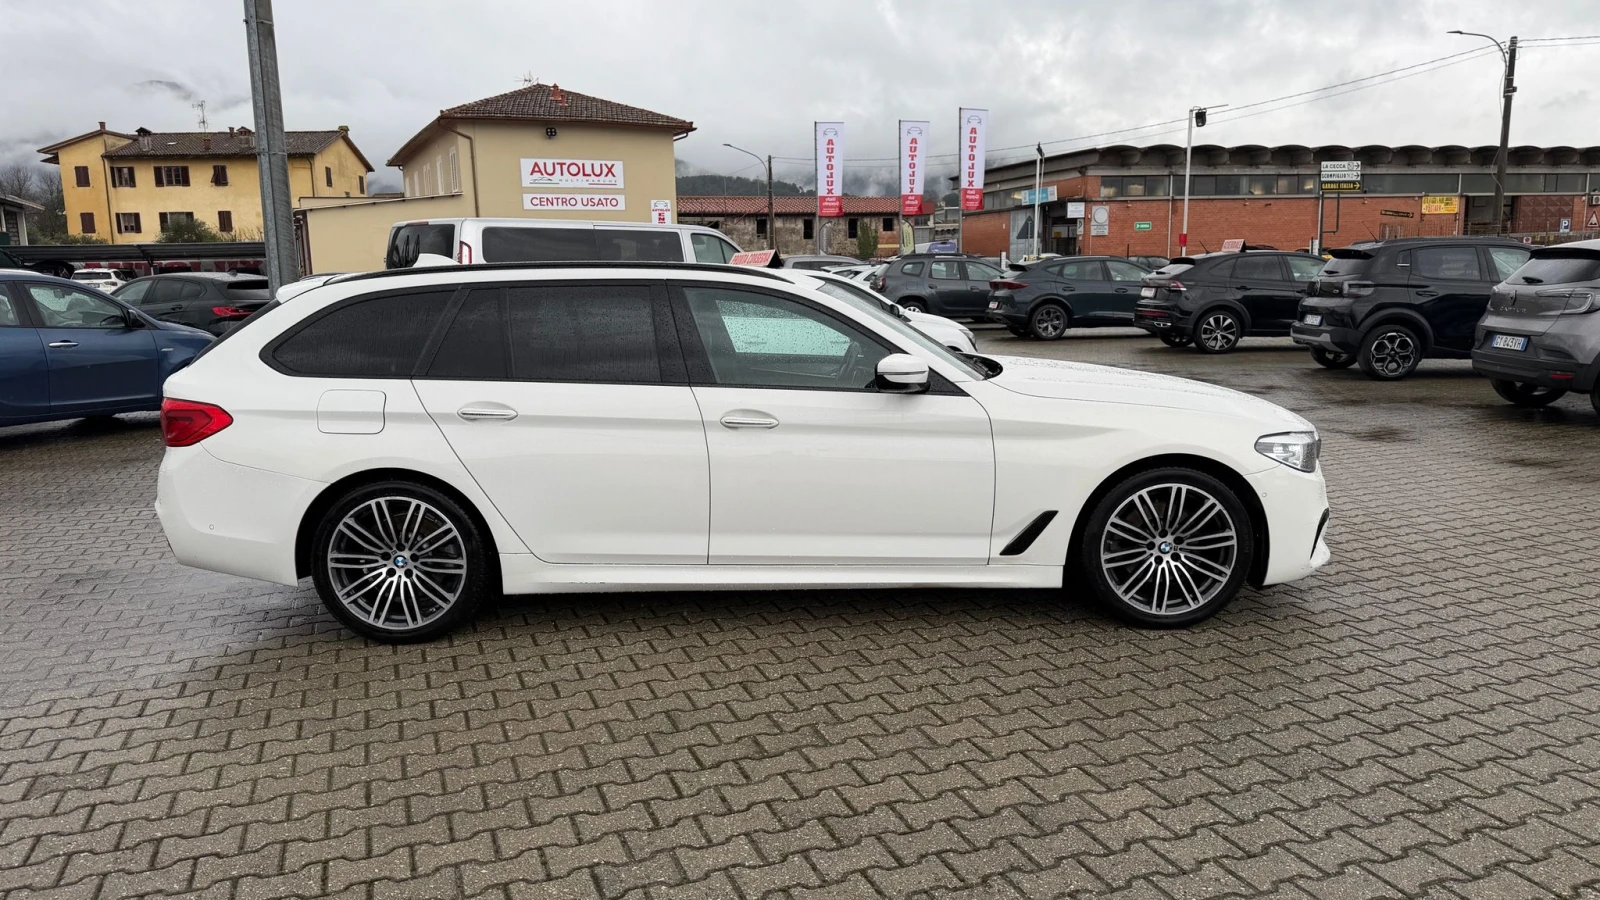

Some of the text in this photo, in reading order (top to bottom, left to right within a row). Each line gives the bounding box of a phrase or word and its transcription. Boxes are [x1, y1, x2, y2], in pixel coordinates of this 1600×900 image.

[530, 162, 616, 178] AUTOLUX
[530, 197, 619, 208] CENTRO USATO
[1500, 306, 1527, 314] CAPTUR
